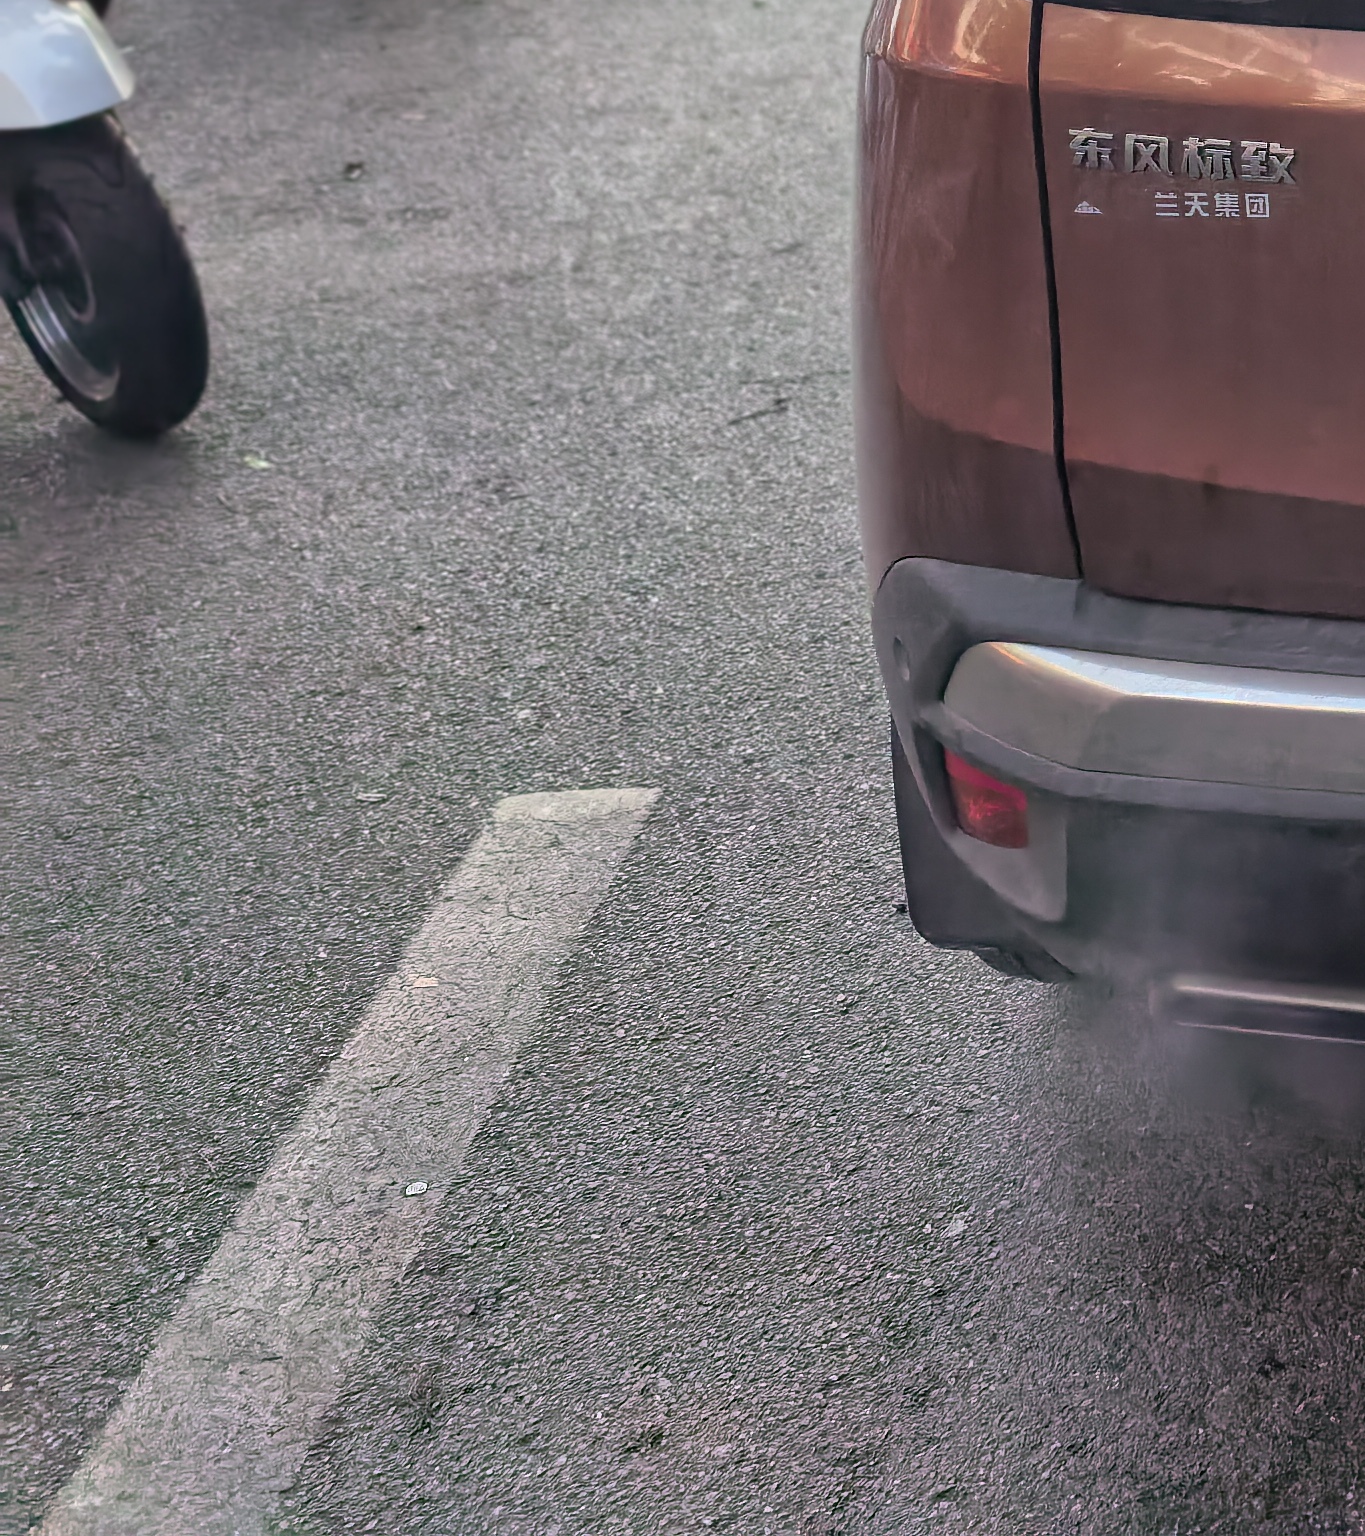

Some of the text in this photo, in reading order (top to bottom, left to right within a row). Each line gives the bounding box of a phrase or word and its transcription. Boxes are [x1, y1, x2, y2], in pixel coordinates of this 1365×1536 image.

[1068, 127, 1296, 184] 东风标致
[1154, 191, 1270, 218] 兰天集团
